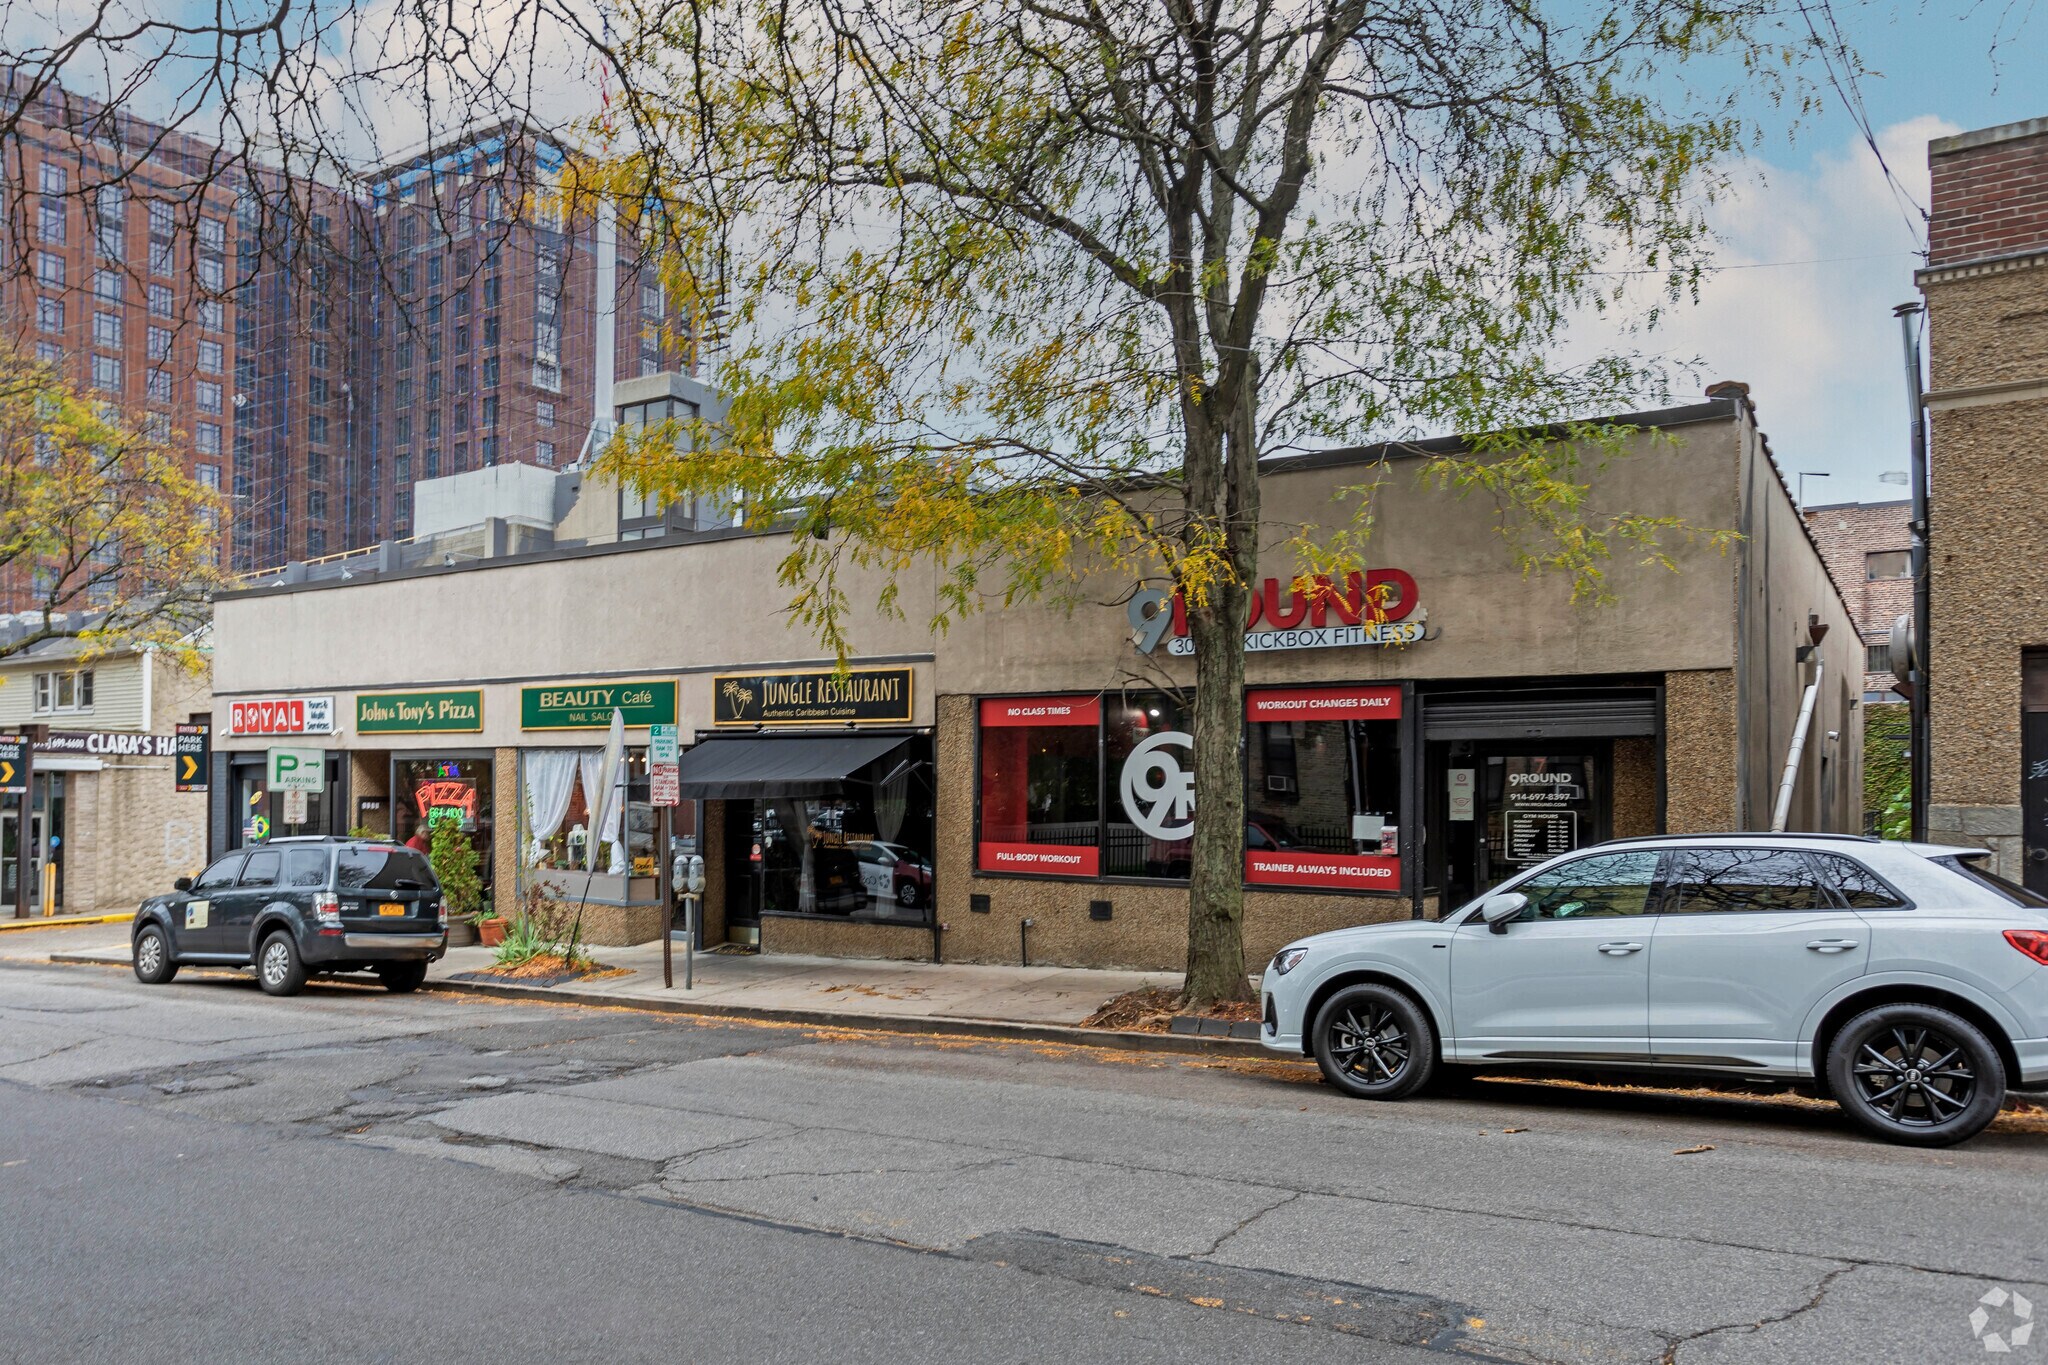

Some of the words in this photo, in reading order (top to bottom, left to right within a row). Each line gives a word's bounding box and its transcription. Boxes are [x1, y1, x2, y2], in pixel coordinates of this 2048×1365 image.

[1128, 568, 1419, 655] 9UND
[1243, 629, 1327, 650] KICKBOX
[540, 689, 615, 708] BEAUTY
[622, 690, 652, 704] Café
[762, 680, 812, 708] JUNGLE
[817, 677, 900, 704] RESTAURANT
[1257, 700, 1308, 709] WORKOUT
[1309, 698, 1358, 708] CHANGES
[1360, 697, 1391, 707] DAILY
[569, 713, 588, 722] NAIL
[591, 711, 613, 721] SALO
[763, 710, 794, 718] Authentic
[796, 709, 829, 717] Caribbean
[831, 707, 856, 716] Cuisine
[86, 733, 152, 755] CLARA'S
[178, 736, 202, 744] PARK
[178, 744, 202, 752] HERE
[1509, 773, 1572, 786] 9ROUND
[415, 781, 475, 818] PIZZA
[997, 853, 1037, 862] FULL-BODY
[1040, 855, 1081, 864] WORKOUT
[1254, 863, 1294, 872] TRAINER
[1296, 865, 1337, 874] ALWAYS
[1340, 867, 1391, 877] INCLUDED
